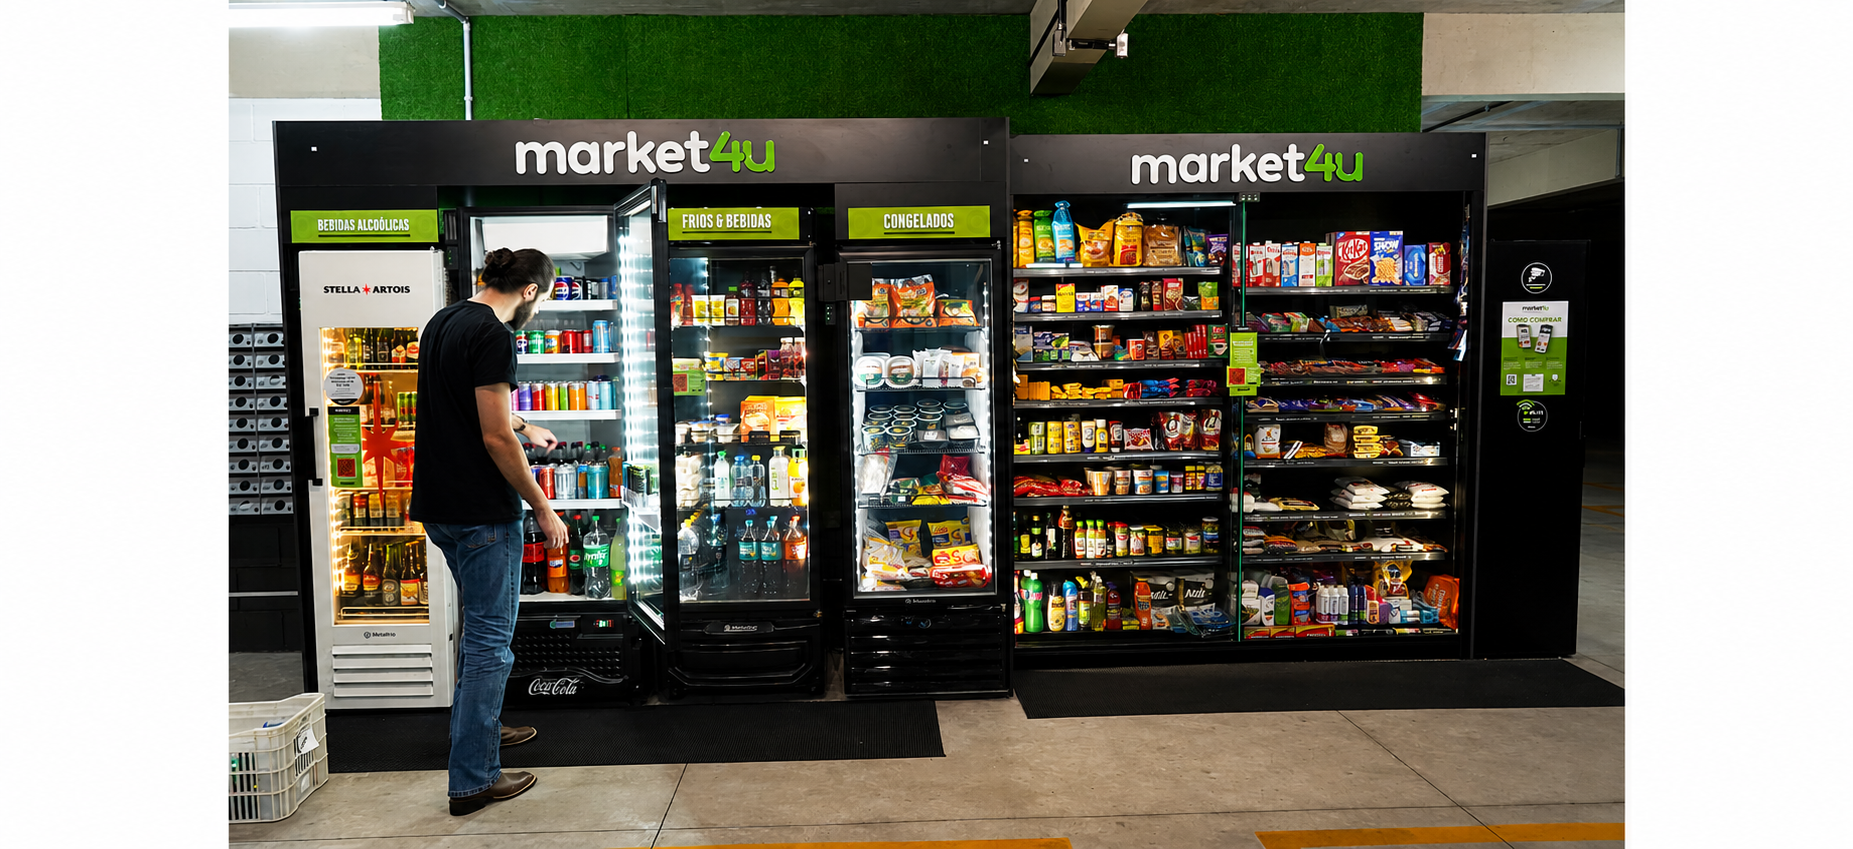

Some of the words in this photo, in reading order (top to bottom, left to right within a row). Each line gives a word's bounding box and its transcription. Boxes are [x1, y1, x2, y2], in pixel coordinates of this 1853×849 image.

[515, 130, 775, 174] market4u
[1131, 143, 1364, 185] market4u
[317, 218, 356, 232] BEBIDAS
[357, 216, 410, 232] ALCOÓLICAS
[682, 213, 714, 229] FRIOS
[715, 214, 724, 228] &
[726, 213, 772, 229] BEBIDAS
[883, 213, 954, 229] CONGELADOS
[323, 285, 361, 294] STELLA
[372, 285, 411, 294] ARTOIS
